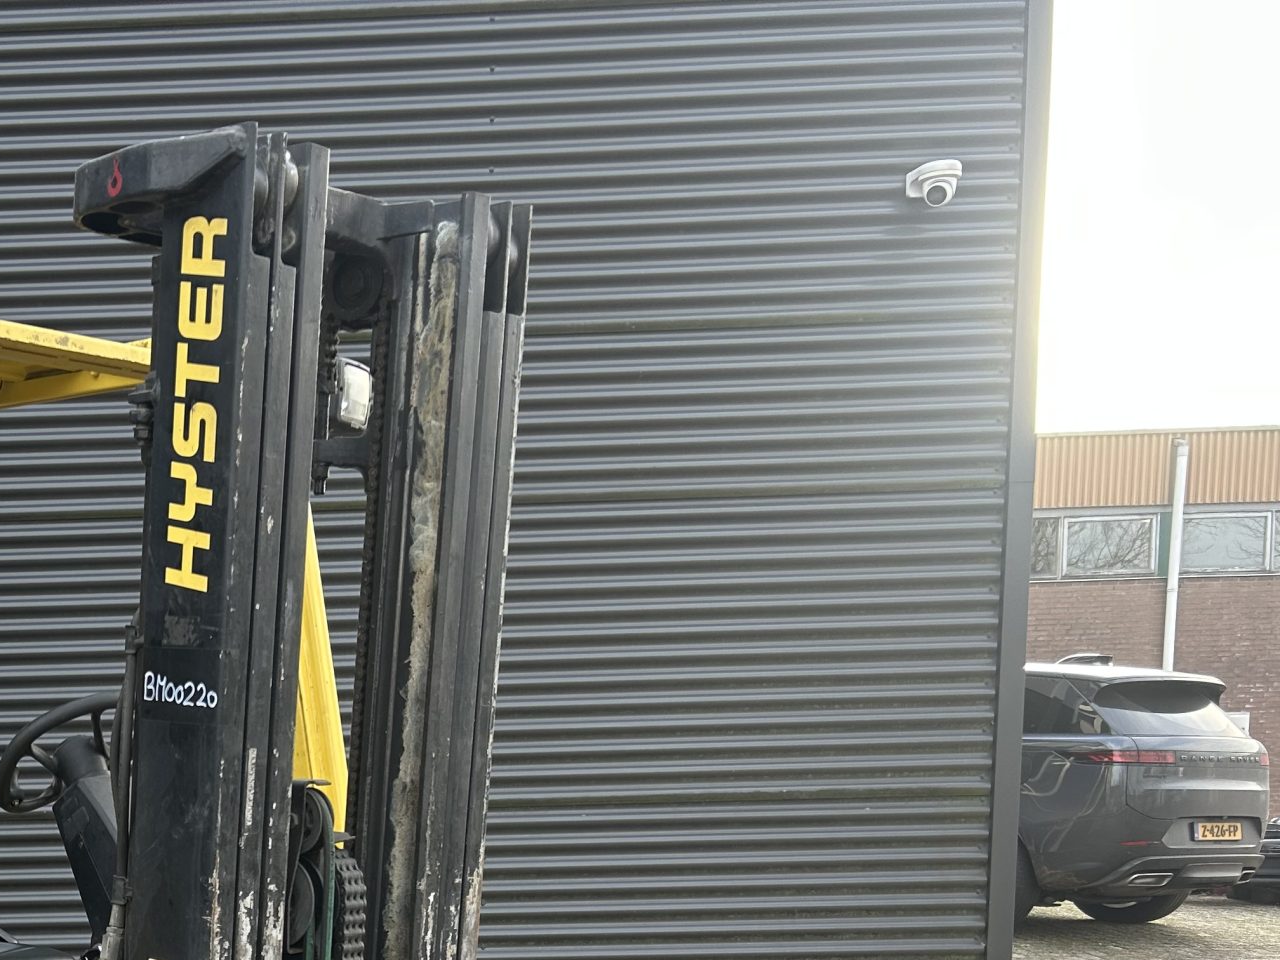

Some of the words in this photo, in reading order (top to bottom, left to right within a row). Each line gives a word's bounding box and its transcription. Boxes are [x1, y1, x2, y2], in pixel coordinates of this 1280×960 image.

[165, 215, 228, 593] HYSTER
[143, 670, 218, 709] BM00220
[1201, 824, 1239, 838] Z-426-FP
